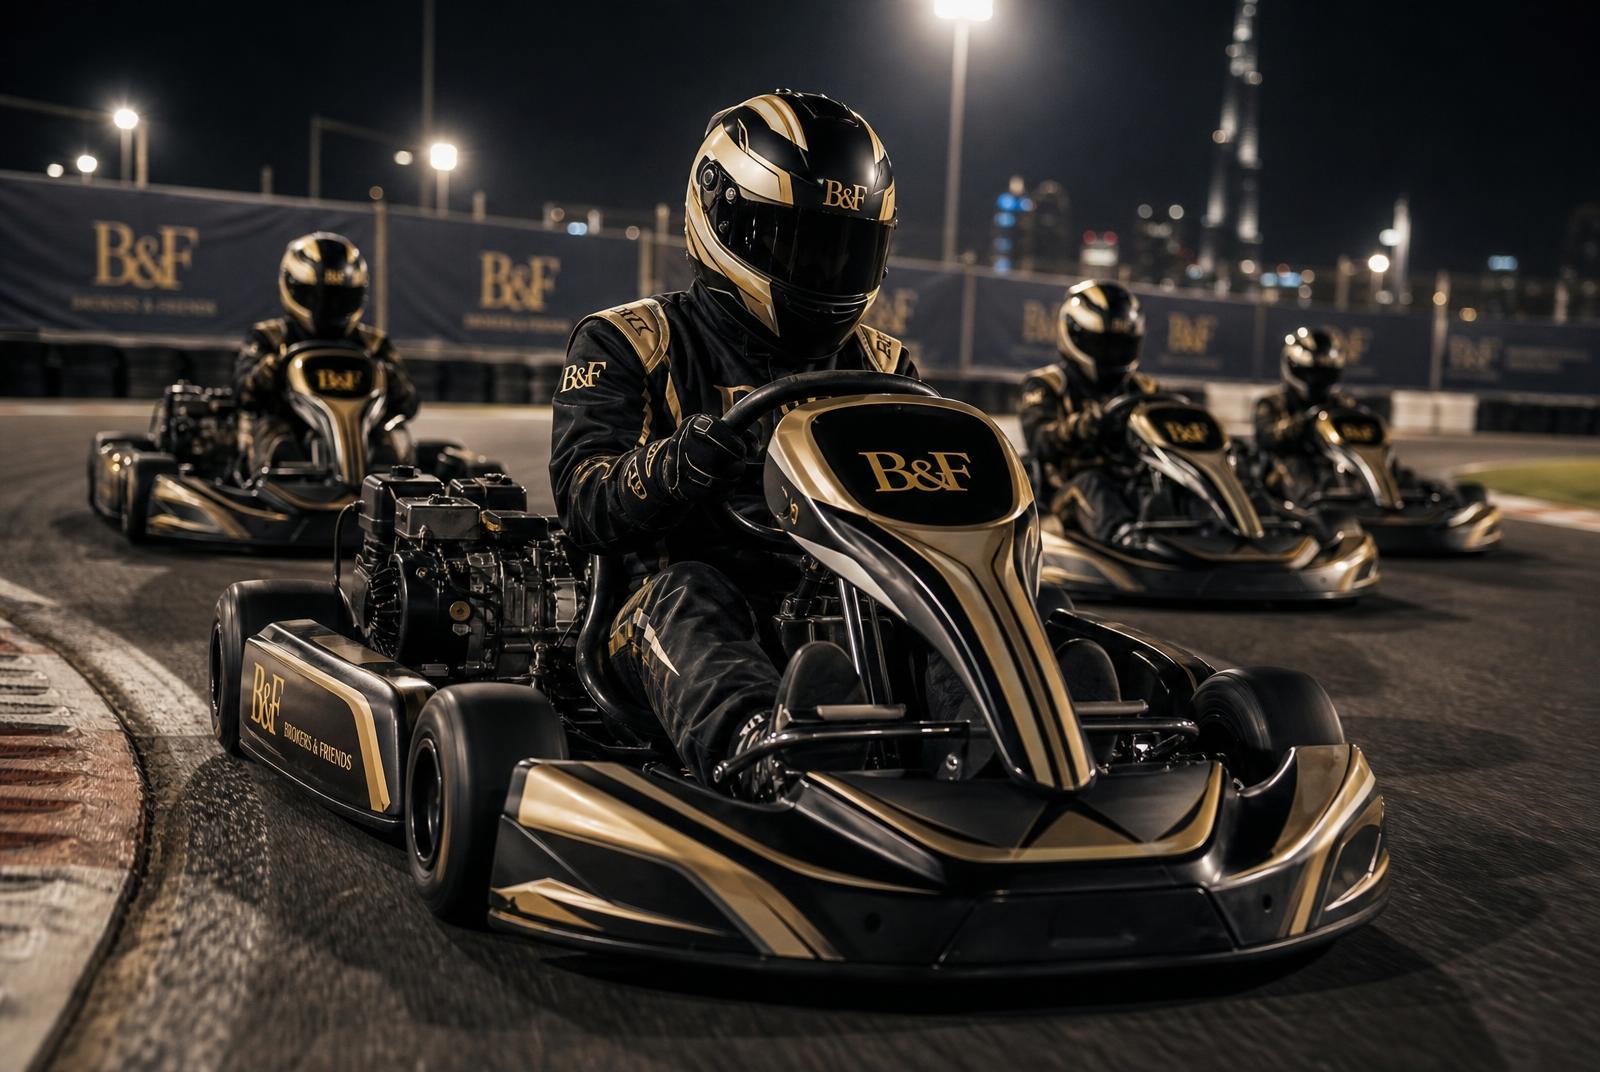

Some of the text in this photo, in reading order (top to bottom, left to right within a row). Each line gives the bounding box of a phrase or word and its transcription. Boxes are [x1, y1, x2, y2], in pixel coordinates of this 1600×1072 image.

[822, 178, 868, 211] B&F
[94, 220, 199, 291] B&F
[480, 251, 561, 312] B&F
[317, 369, 362, 391] B&F
[560, 361, 607, 393] B&F
[858, 451, 971, 492] B&F
[251, 662, 284, 735] B&F
[284, 722, 352, 771] BROKERS & FRIENDS
